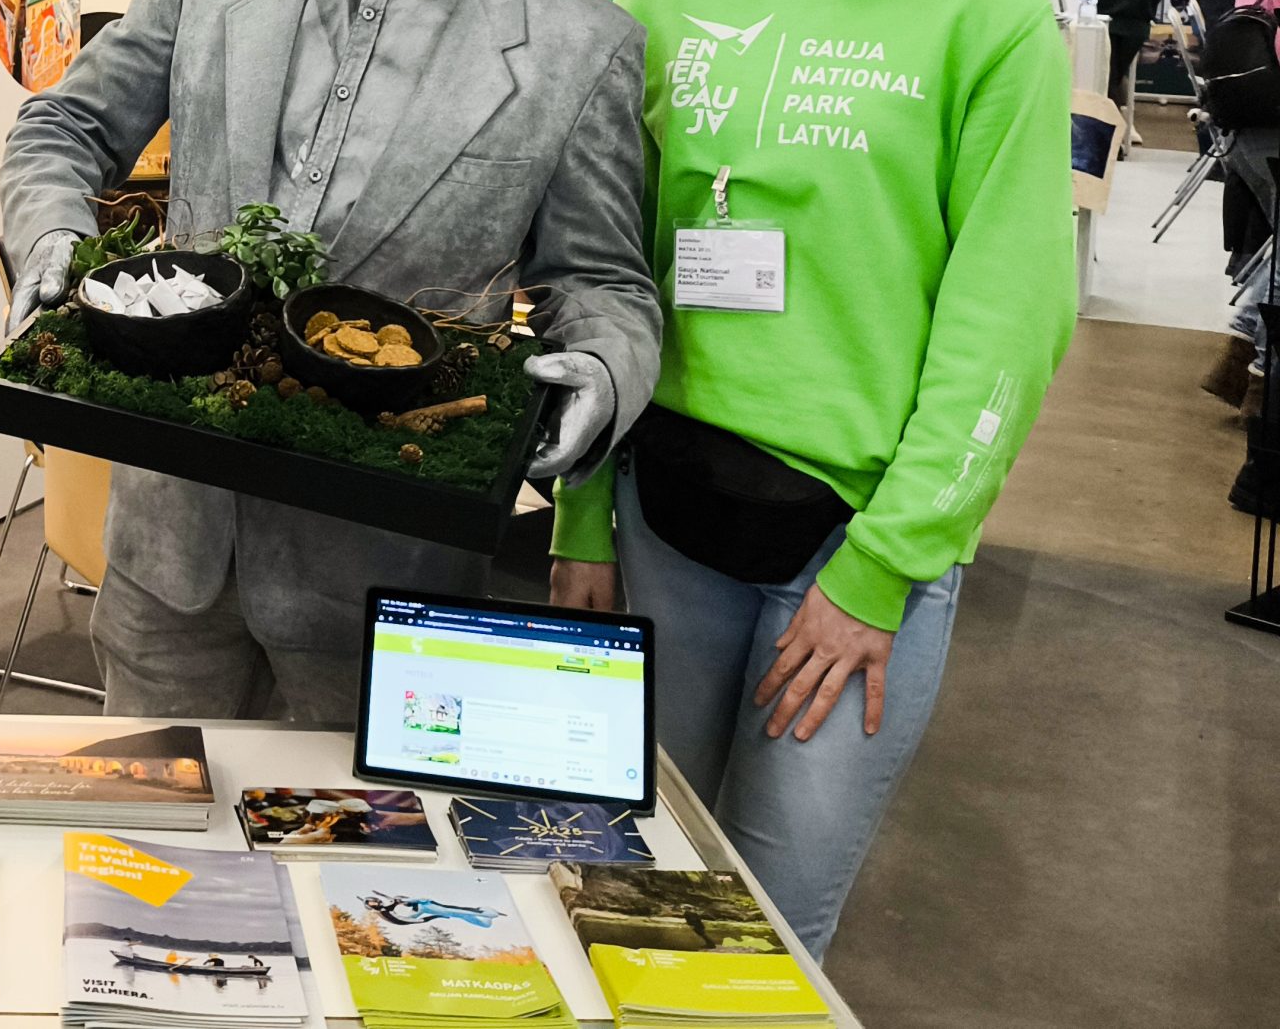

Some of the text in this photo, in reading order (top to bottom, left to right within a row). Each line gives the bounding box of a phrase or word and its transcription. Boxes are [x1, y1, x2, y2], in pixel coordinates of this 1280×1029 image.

[677, 37, 718, 59] EN
[800, 38, 884, 61] GAUJA
[671, 60, 710, 86] ER
[791, 66, 925, 100] NATIONAL
[671, 84, 738, 109] GAU
[783, 94, 855, 116] PARK
[778, 123, 869, 152] LATVIA
[79, 842, 135, 858] Travel
[79, 852, 181, 876] in Valmiera
[79, 865, 143, 881] region!
[82, 978, 115, 987] VISIT
[83, 986, 154, 999] VALMIERA.
